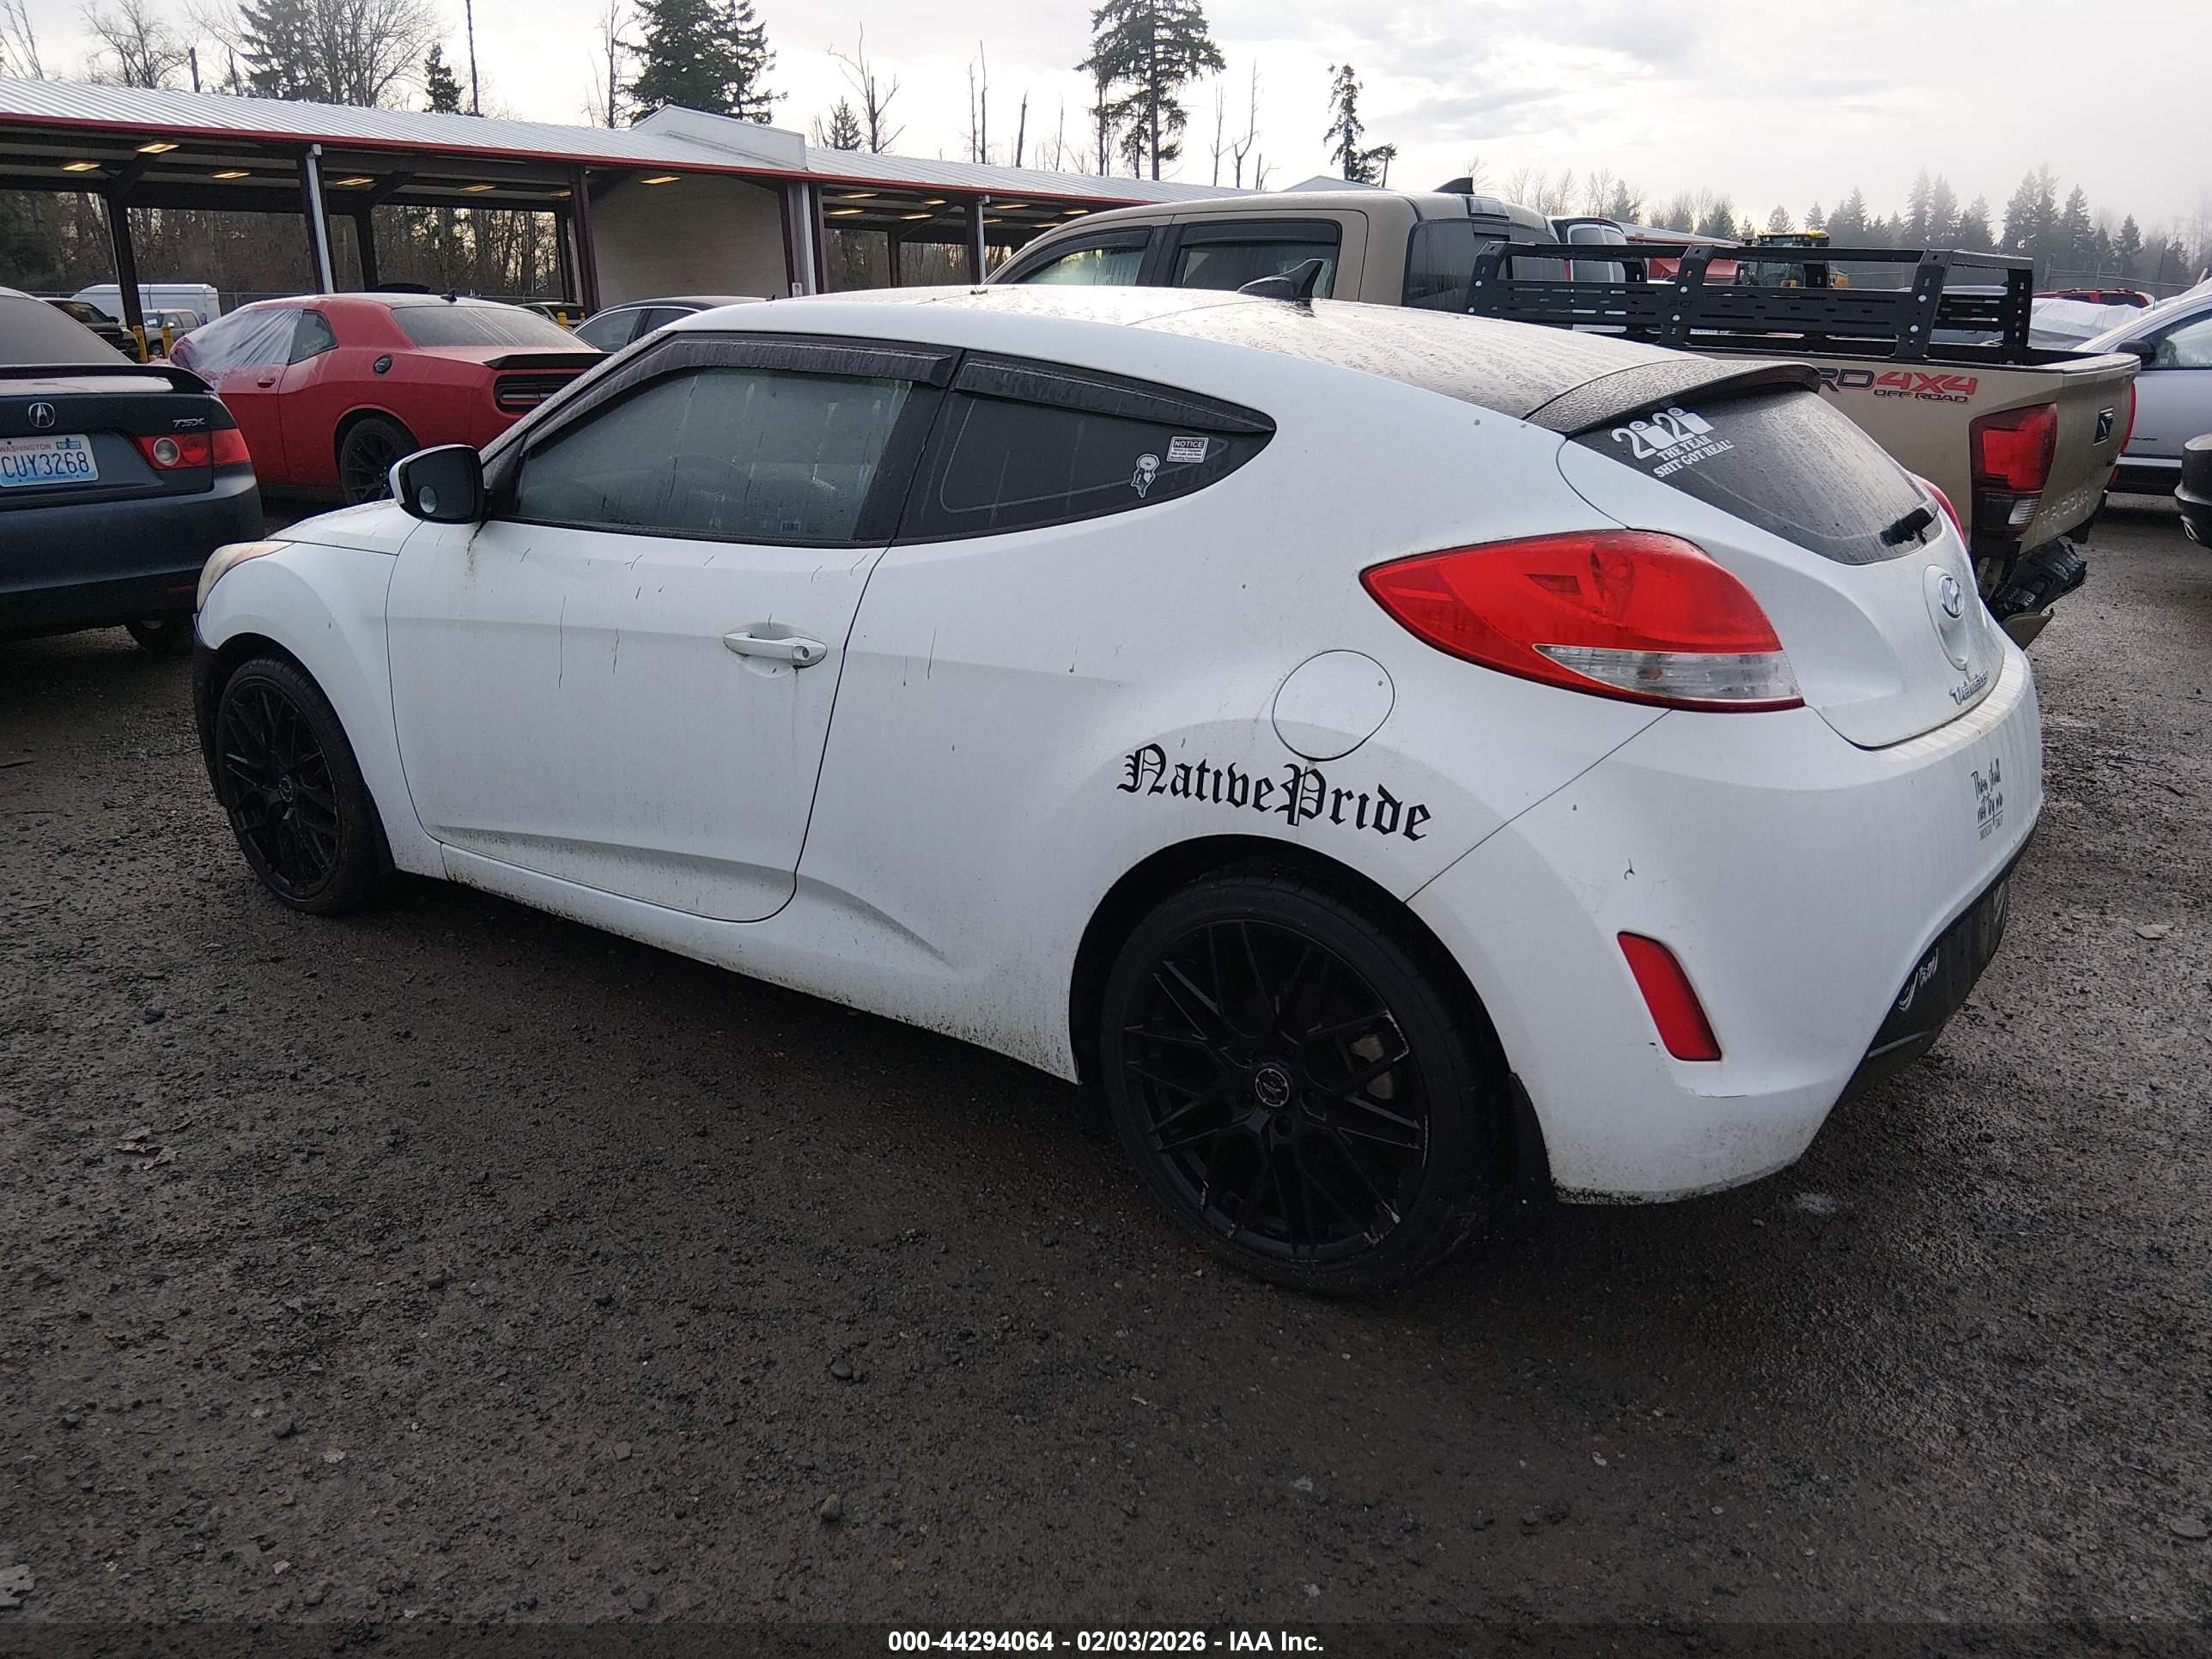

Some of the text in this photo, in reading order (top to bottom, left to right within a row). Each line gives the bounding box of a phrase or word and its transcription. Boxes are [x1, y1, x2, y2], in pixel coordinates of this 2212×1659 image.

[1819, 367, 1979, 396] RD 4X4
[1874, 389, 1969, 404] OFF ROAD
[172, 417, 206, 428] TSX
[1174, 440, 1204, 448] NOTICE
[1656, 434, 1714, 461] THE YEAR
[1, 452, 90, 478] CUY3268
[1653, 459, 1684, 478] SHIT
[1680, 450, 1706, 465] GOT
